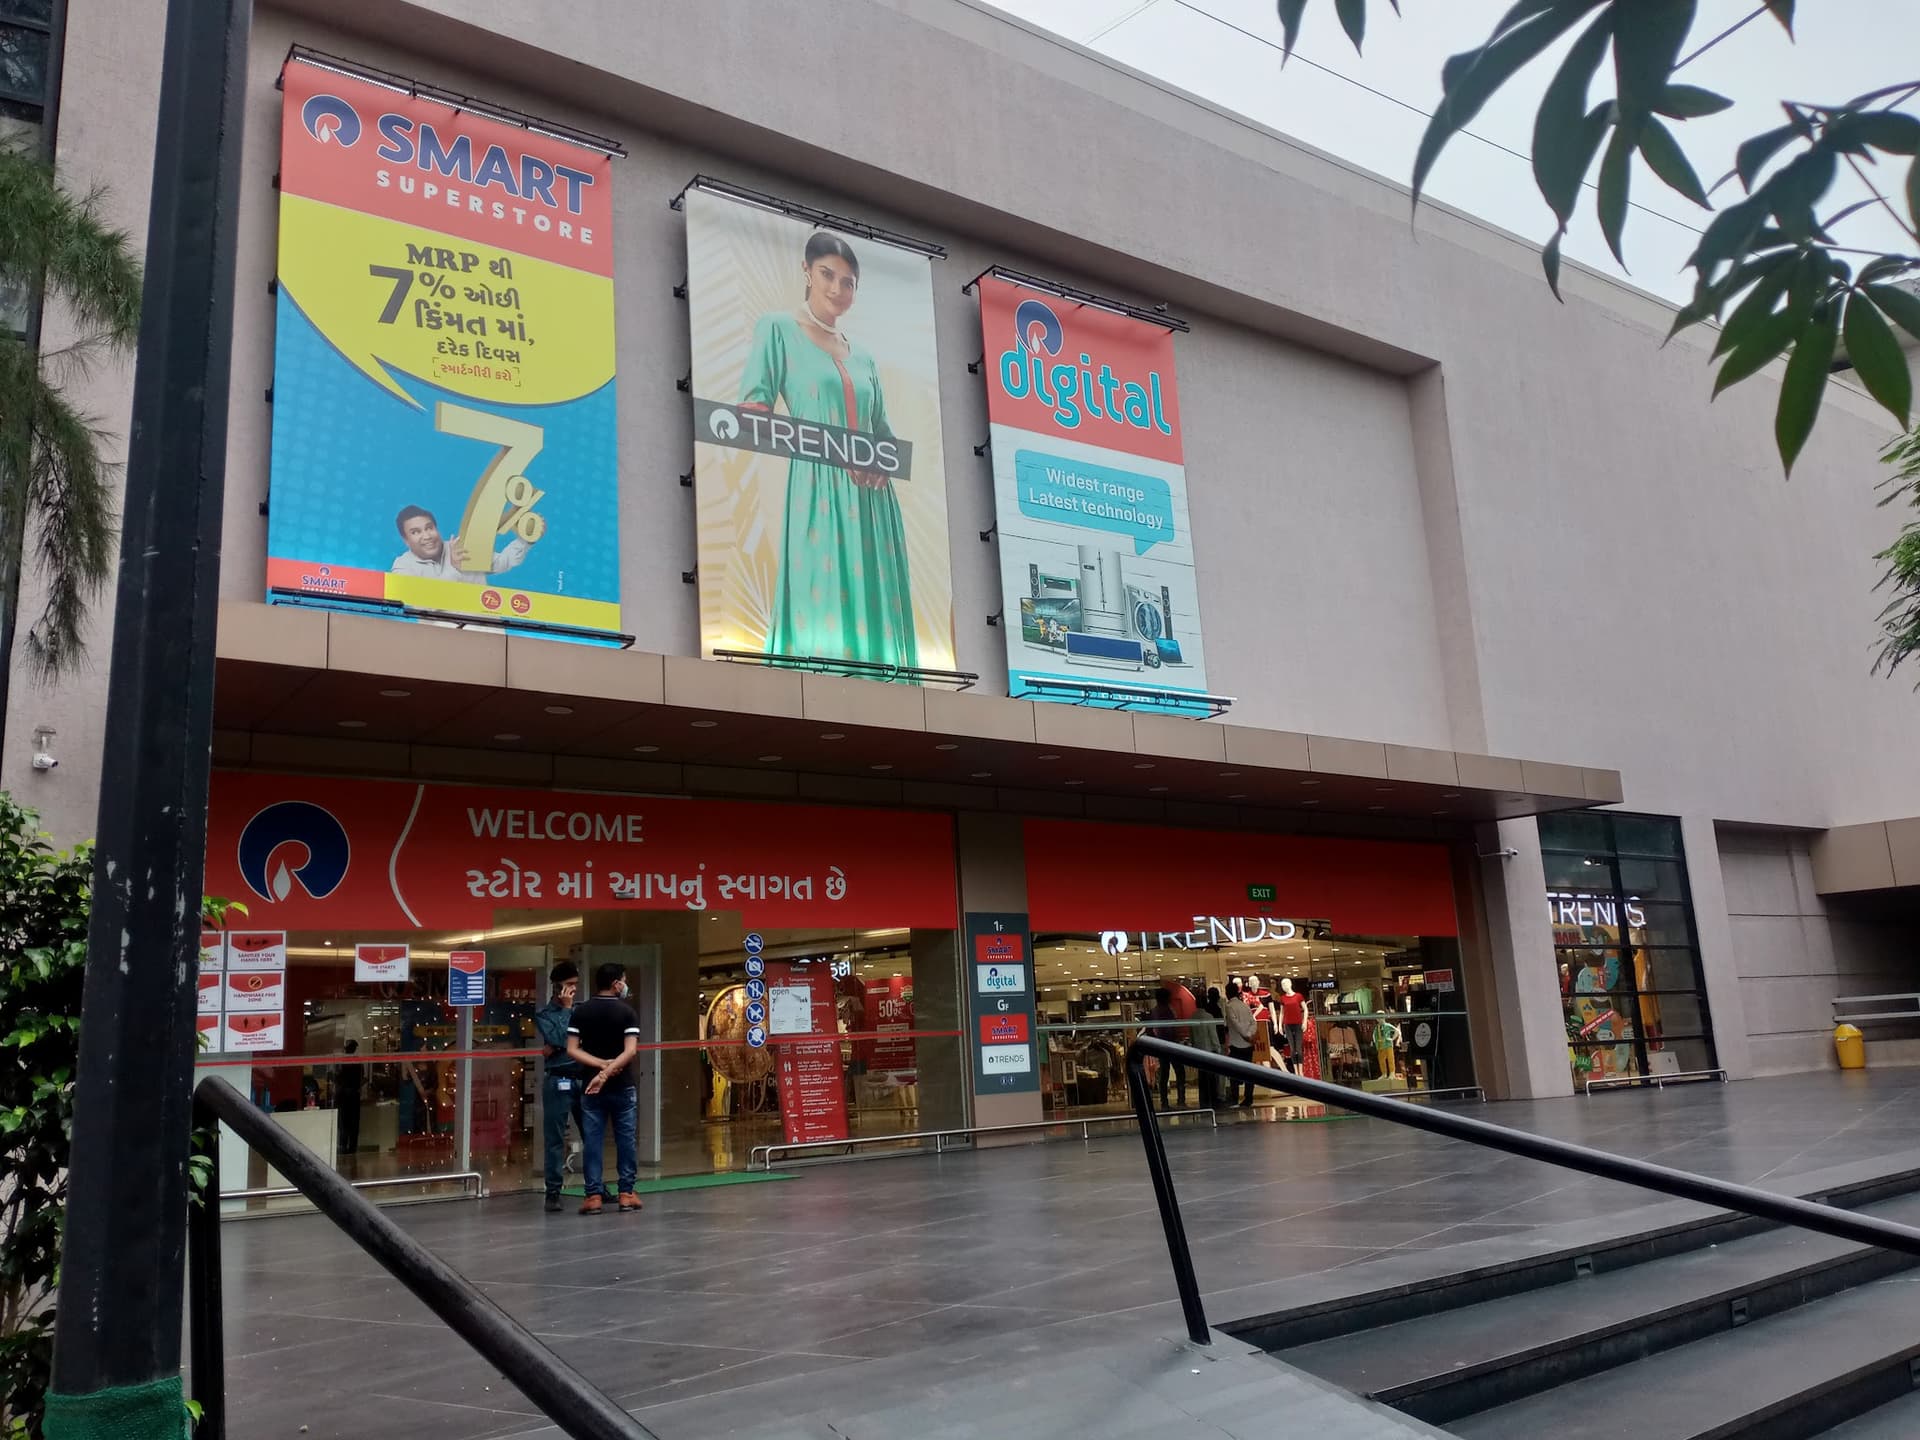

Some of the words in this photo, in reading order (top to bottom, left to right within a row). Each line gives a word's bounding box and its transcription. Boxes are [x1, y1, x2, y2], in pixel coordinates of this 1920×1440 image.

[377, 113, 594, 215] SMART
[376, 170, 593, 244] SUPERSTORE
[405, 243, 480, 273] MRP
[489, 257, 513, 280] થી
[464, 283, 521, 310] ઓછી
[414, 298, 487, 336] કિંમત
[437, 336, 470, 357] દરેક
[475, 340, 521, 363] દિવસ
[1000, 335, 1172, 435] digital
[742, 413, 900, 472] TRENDS
[434, 400, 546, 572] 7%
[1046, 465, 1100, 492] Widest
[1103, 482, 1145, 503] range
[1029, 487, 1079, 512] Latest
[1081, 501, 1164, 529] technology
[302, 575, 347, 589] SMART
[467, 808, 644, 842] WELCOME
[466, 858, 542, 898] સ્ટોર
[557, 860, 593, 899] માં
[608, 863, 707, 910] આપનું
[718, 873, 813, 900] સ્વાગત
[825, 866, 847, 900] છે
[1252, 888, 1271, 898] EXIT
[986, 974, 1017, 990] digital
[995, 1055, 1025, 1064] TRENDS
